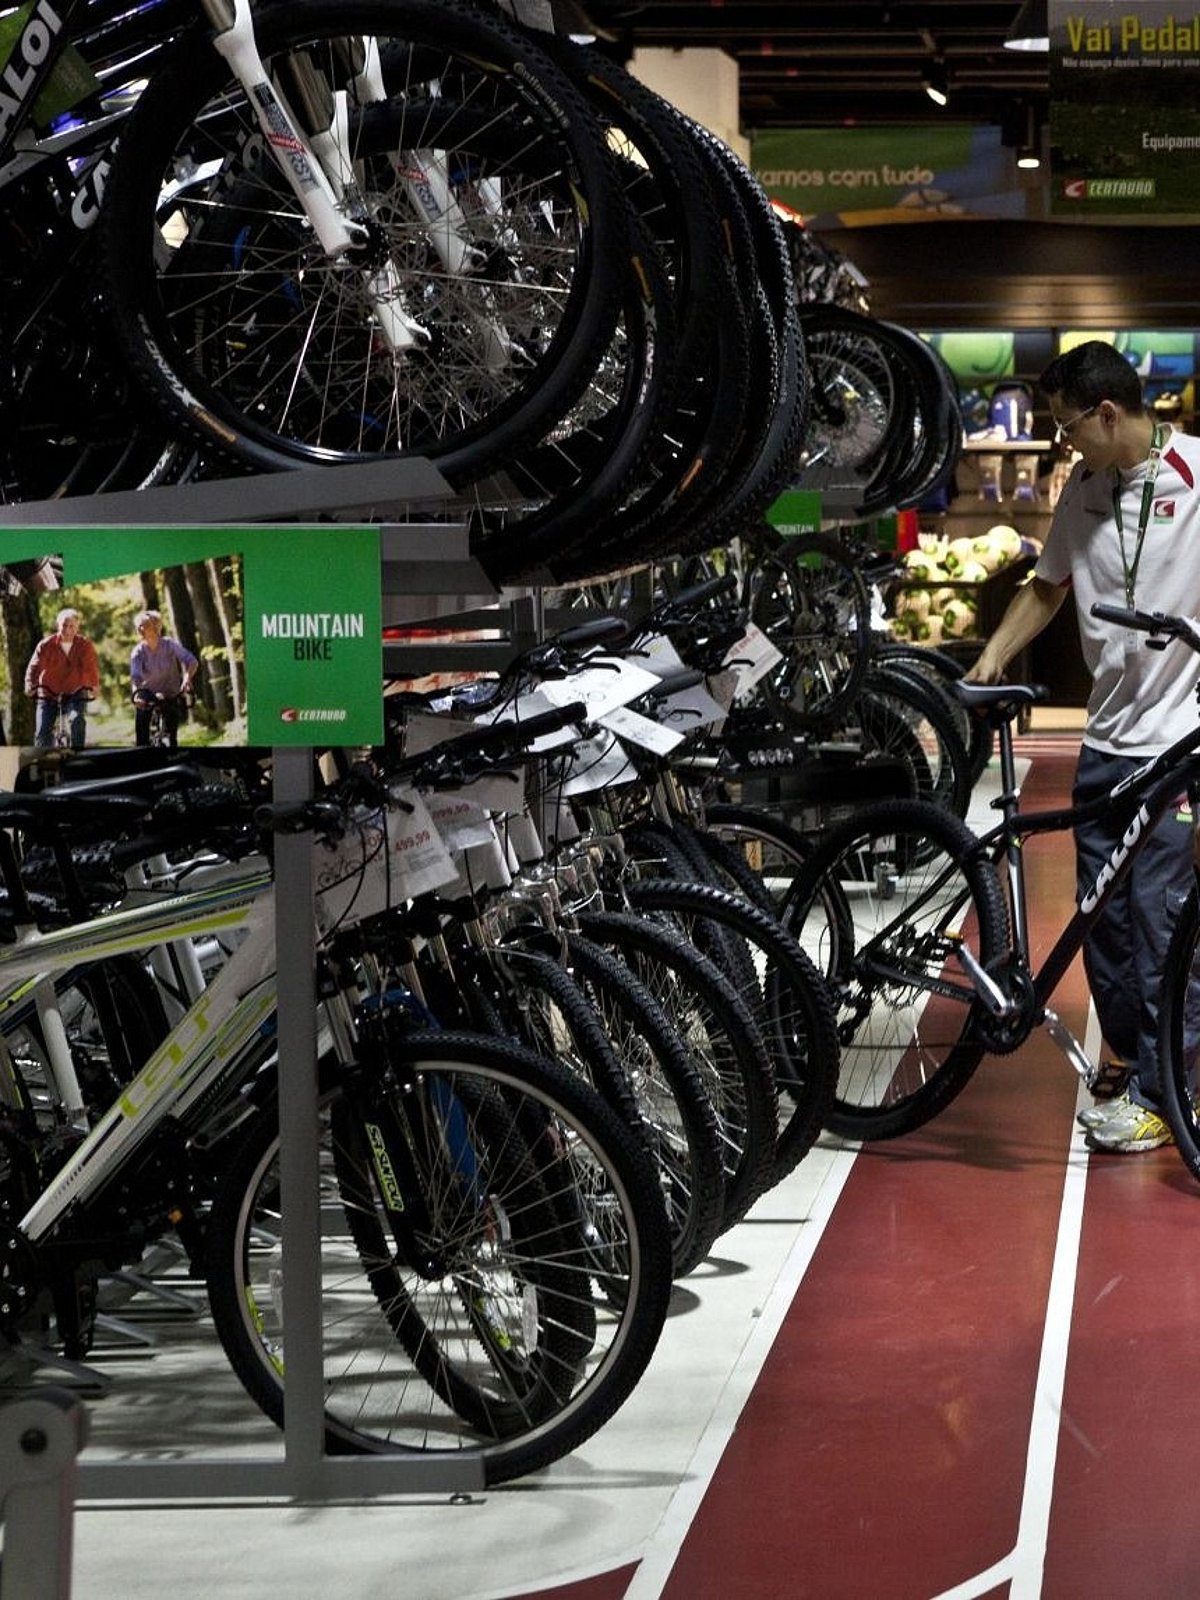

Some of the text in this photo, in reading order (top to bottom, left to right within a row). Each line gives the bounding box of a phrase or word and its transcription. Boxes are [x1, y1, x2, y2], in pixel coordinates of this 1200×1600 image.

[1066, 14, 1200, 52] Vai Pedal
[828, 169, 878, 188] com
[882, 164, 934, 187] tudo
[1089, 180, 1153, 197] CENTAURO
[261, 613, 364, 638] MOUNTAIN
[294, 639, 333, 661] BIKE
[298, 708, 347, 721] CENTAURO
[1081, 803, 1150, 914] CALOI
